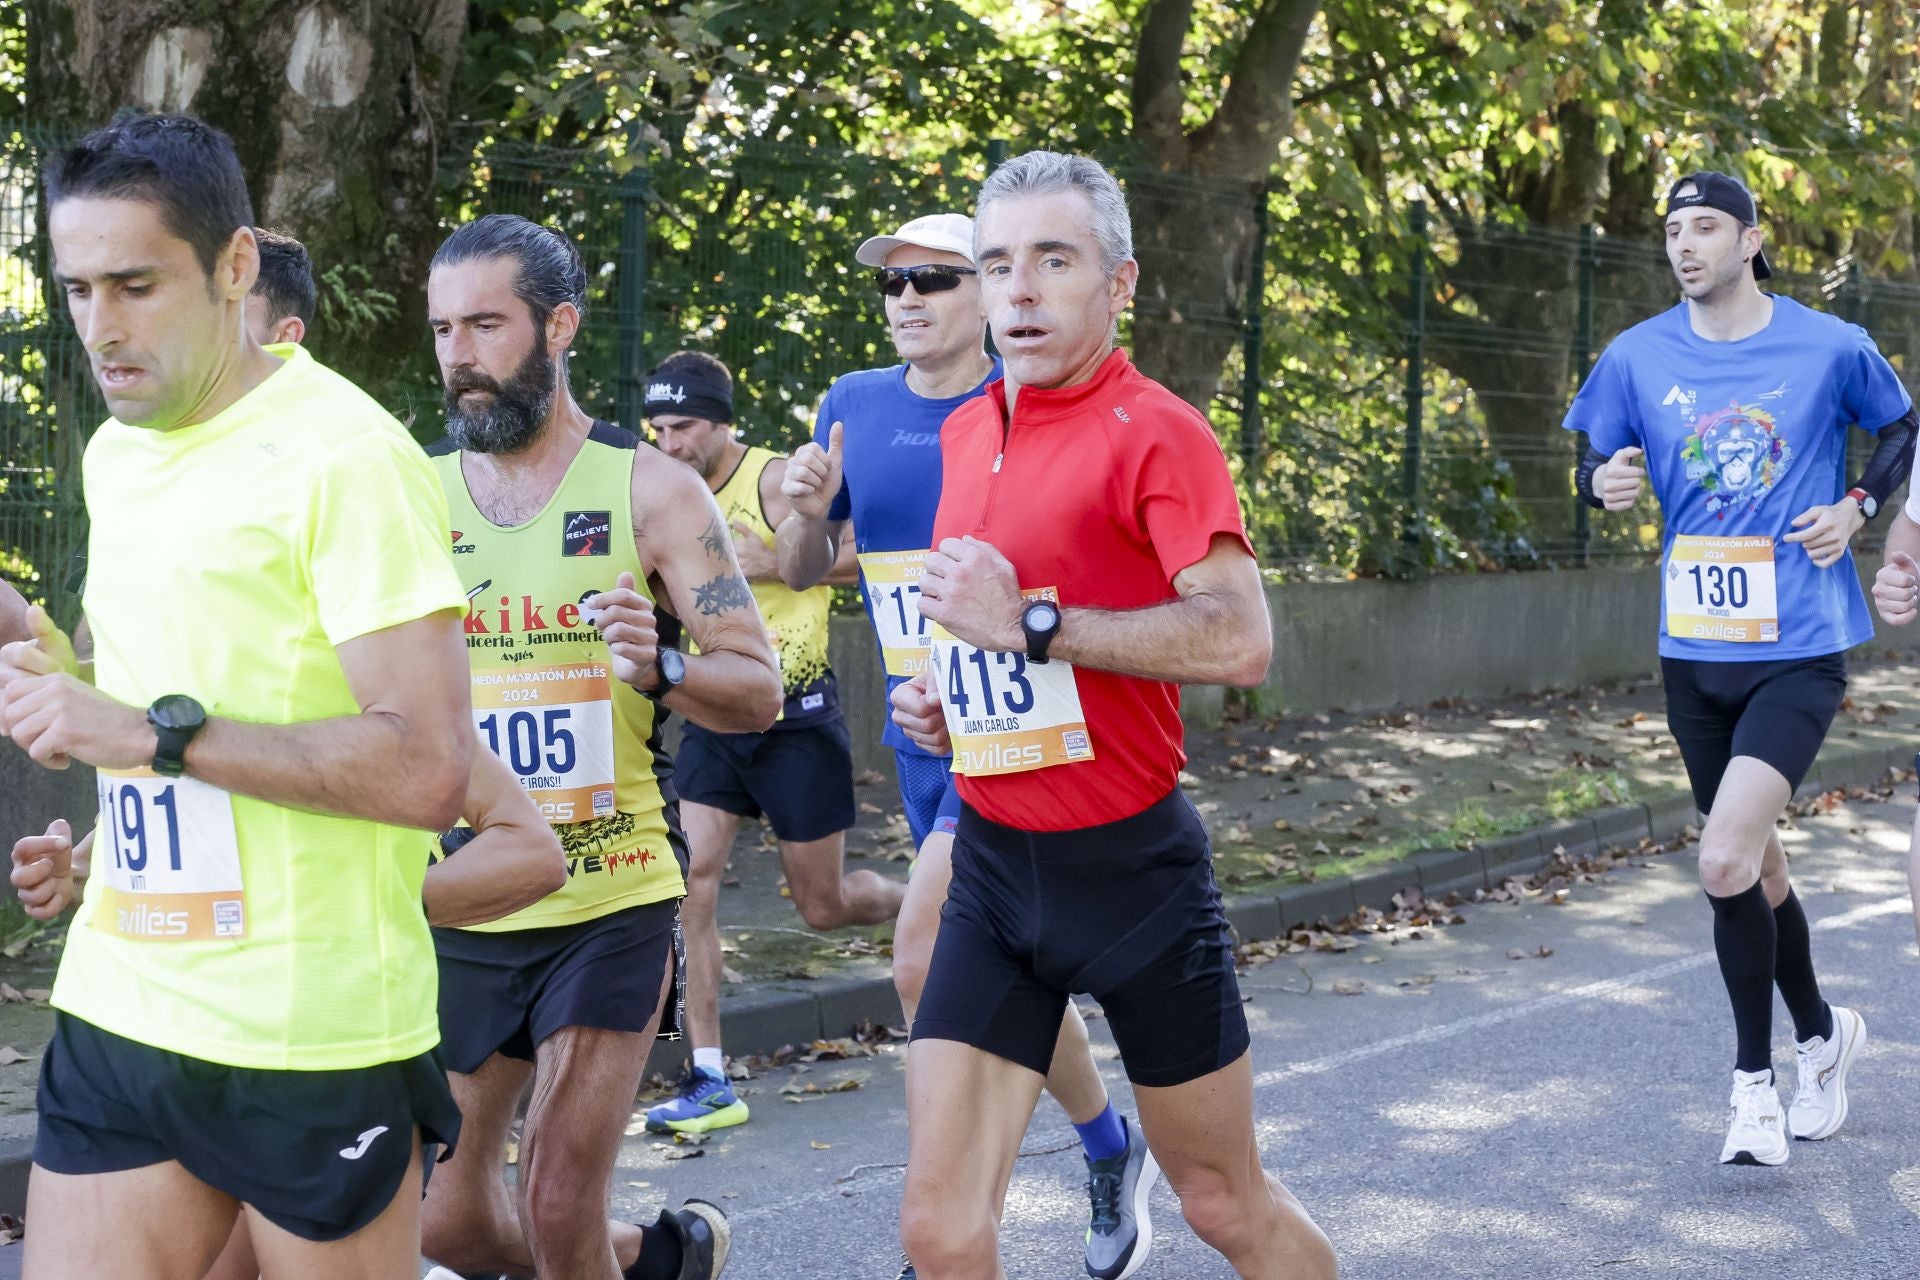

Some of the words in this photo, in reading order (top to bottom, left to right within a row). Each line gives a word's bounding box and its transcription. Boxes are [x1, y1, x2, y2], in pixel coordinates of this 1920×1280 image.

[566, 524, 609, 540] RELIEVE
[1689, 564, 1748, 609] 130
[464, 596, 580, 634] kike
[471, 674, 503, 686] MEDIA
[506, 668, 564, 683] MARATÓN
[567, 668, 607, 680] AVILÉS
[950, 646, 1035, 717] 413
[502, 688, 539, 702] 2024
[964, 719, 984, 734] JUAN
[985, 717, 1020, 733] CARLOS
[479, 709, 576, 776] 105
[961, 742, 1043, 770] avilés
[528, 776, 562, 789] IRONS!!
[108, 784, 182, 872] 191
[117, 904, 190, 936] avilés
